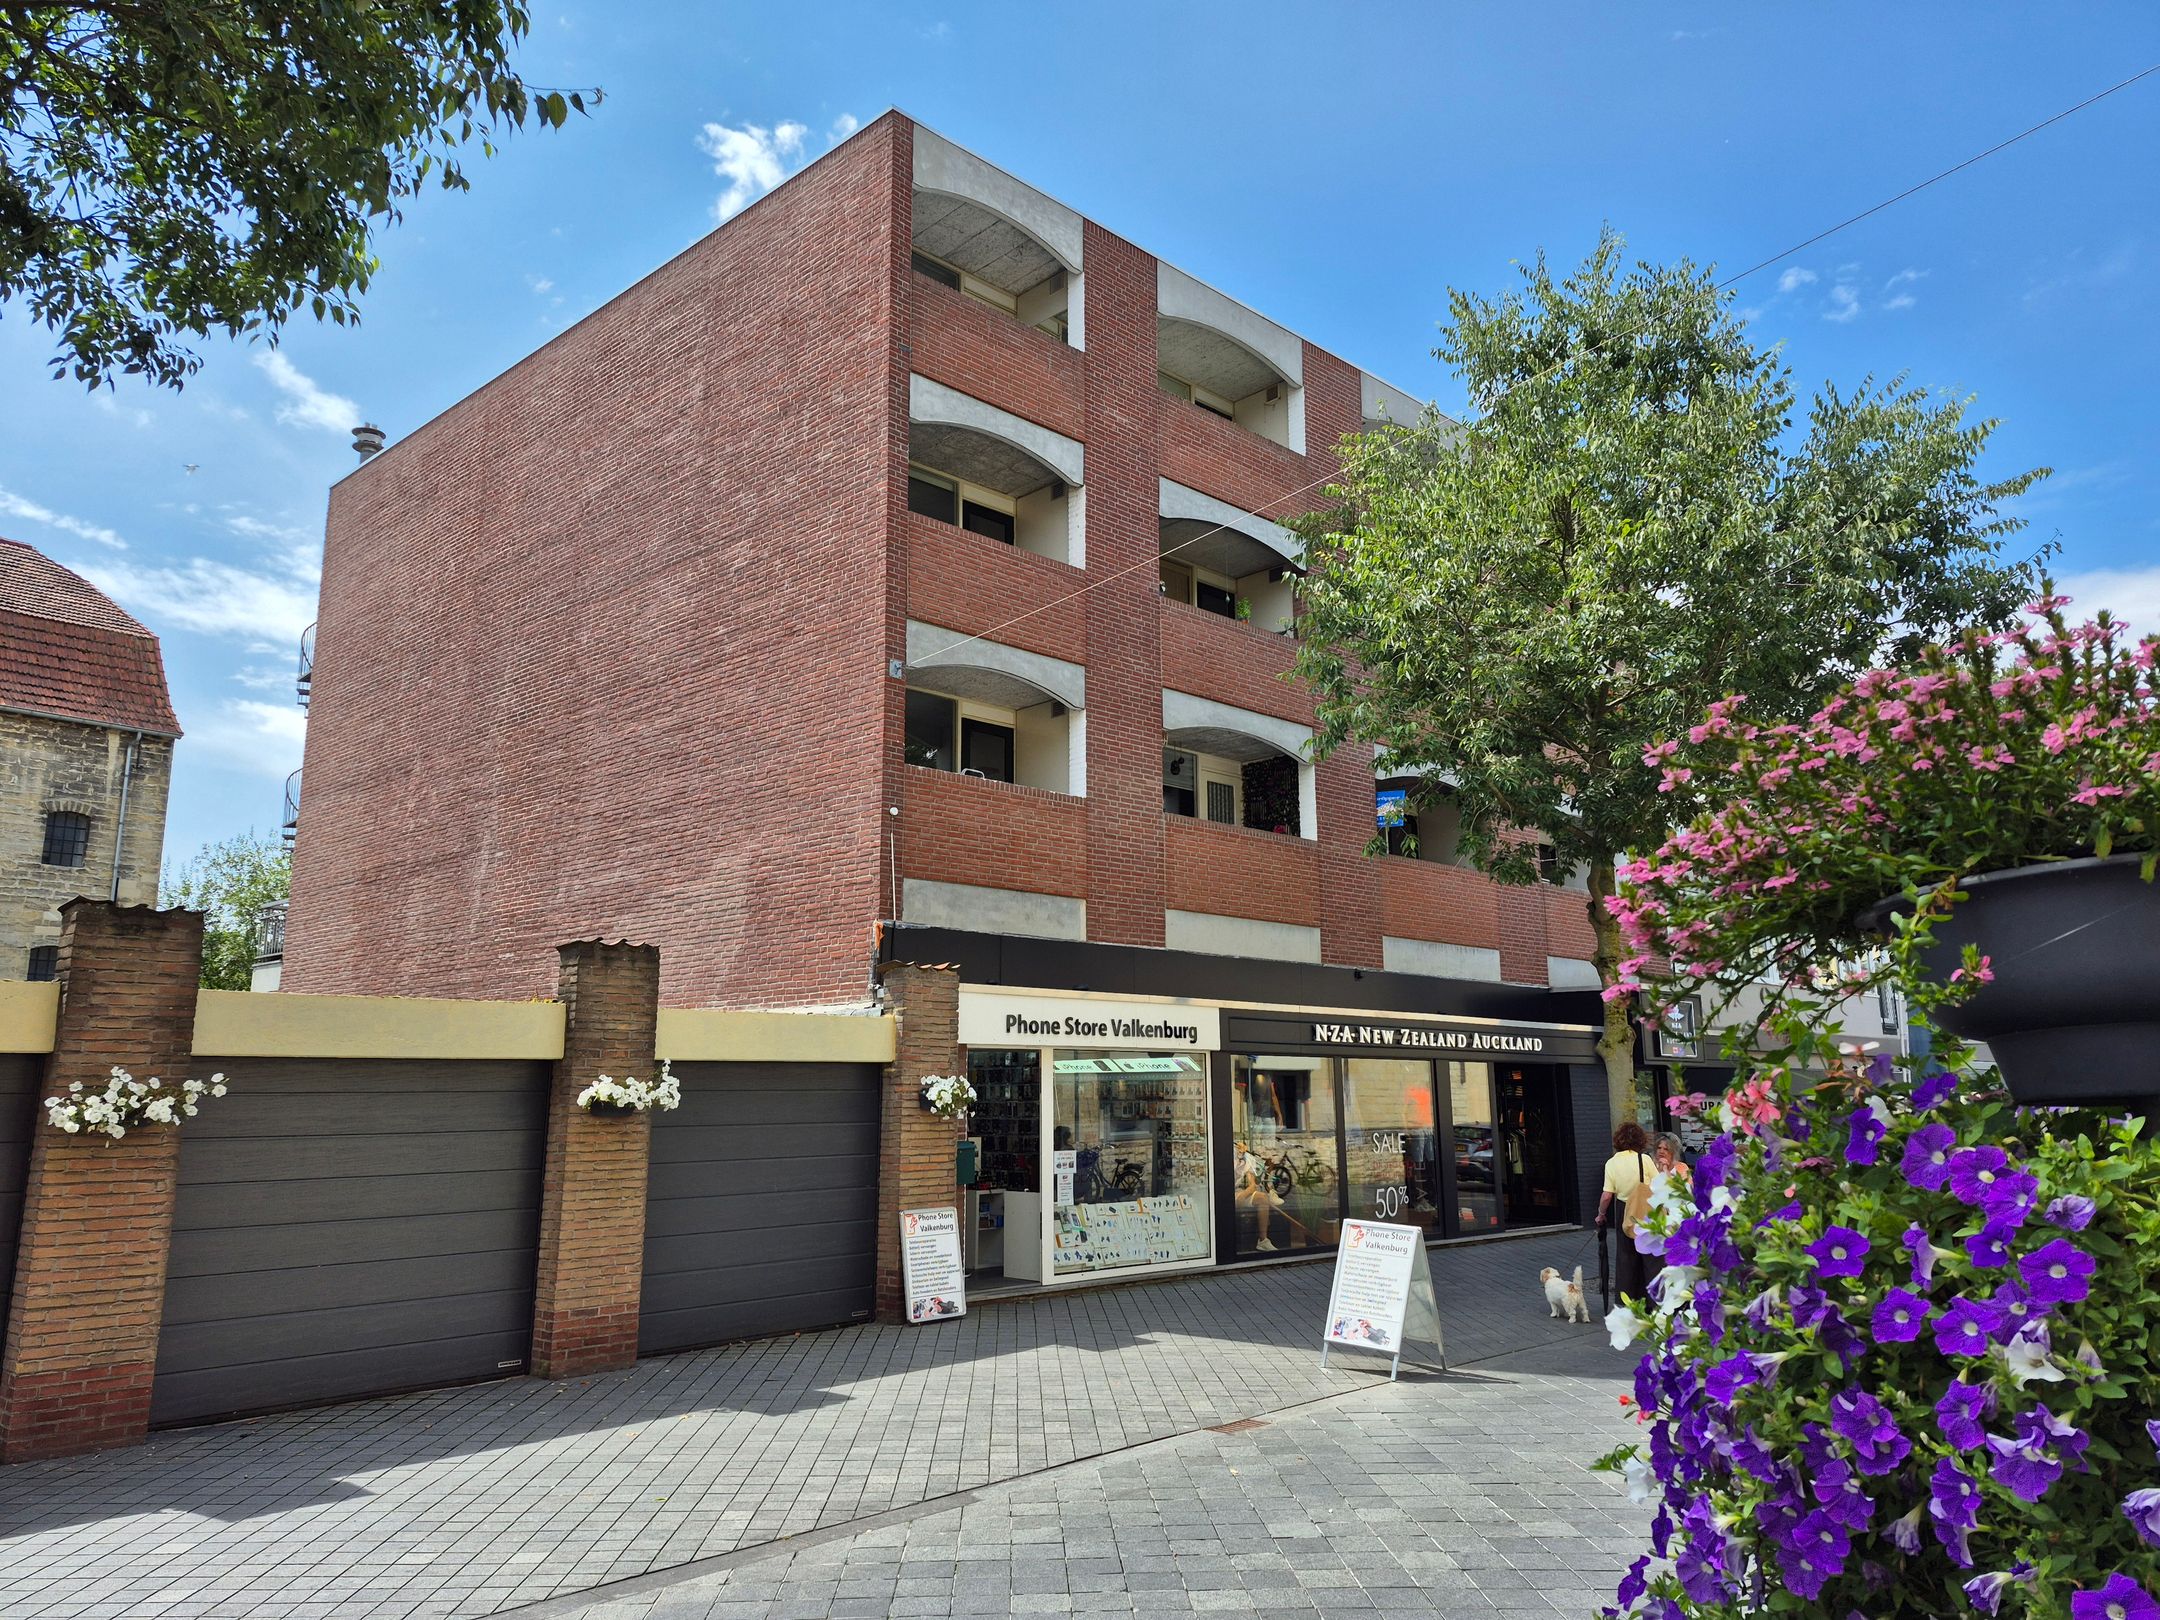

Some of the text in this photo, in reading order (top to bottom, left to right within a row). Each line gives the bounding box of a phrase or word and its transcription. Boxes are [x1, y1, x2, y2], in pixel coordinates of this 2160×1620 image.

[1005, 1014, 1198, 1044] Phone Store Valkenburg
[1400, 1028, 1468, 1048] ZEALAND
[1472, 1032, 1543, 1052] AUCKLAND
[1061, 1063, 1093, 1071] iPhone
[1137, 1062, 1171, 1070] iPhone
[1373, 1132, 1406, 1154] SALE
[1375, 1186, 1410, 1219] 50%
[937, 1212, 953, 1220] Store
[920, 1223, 954, 1232] Valkenburg
[1366, 1228, 1412, 1241] Phone Store
[1365, 1241, 1408, 1255] Valkenburg
